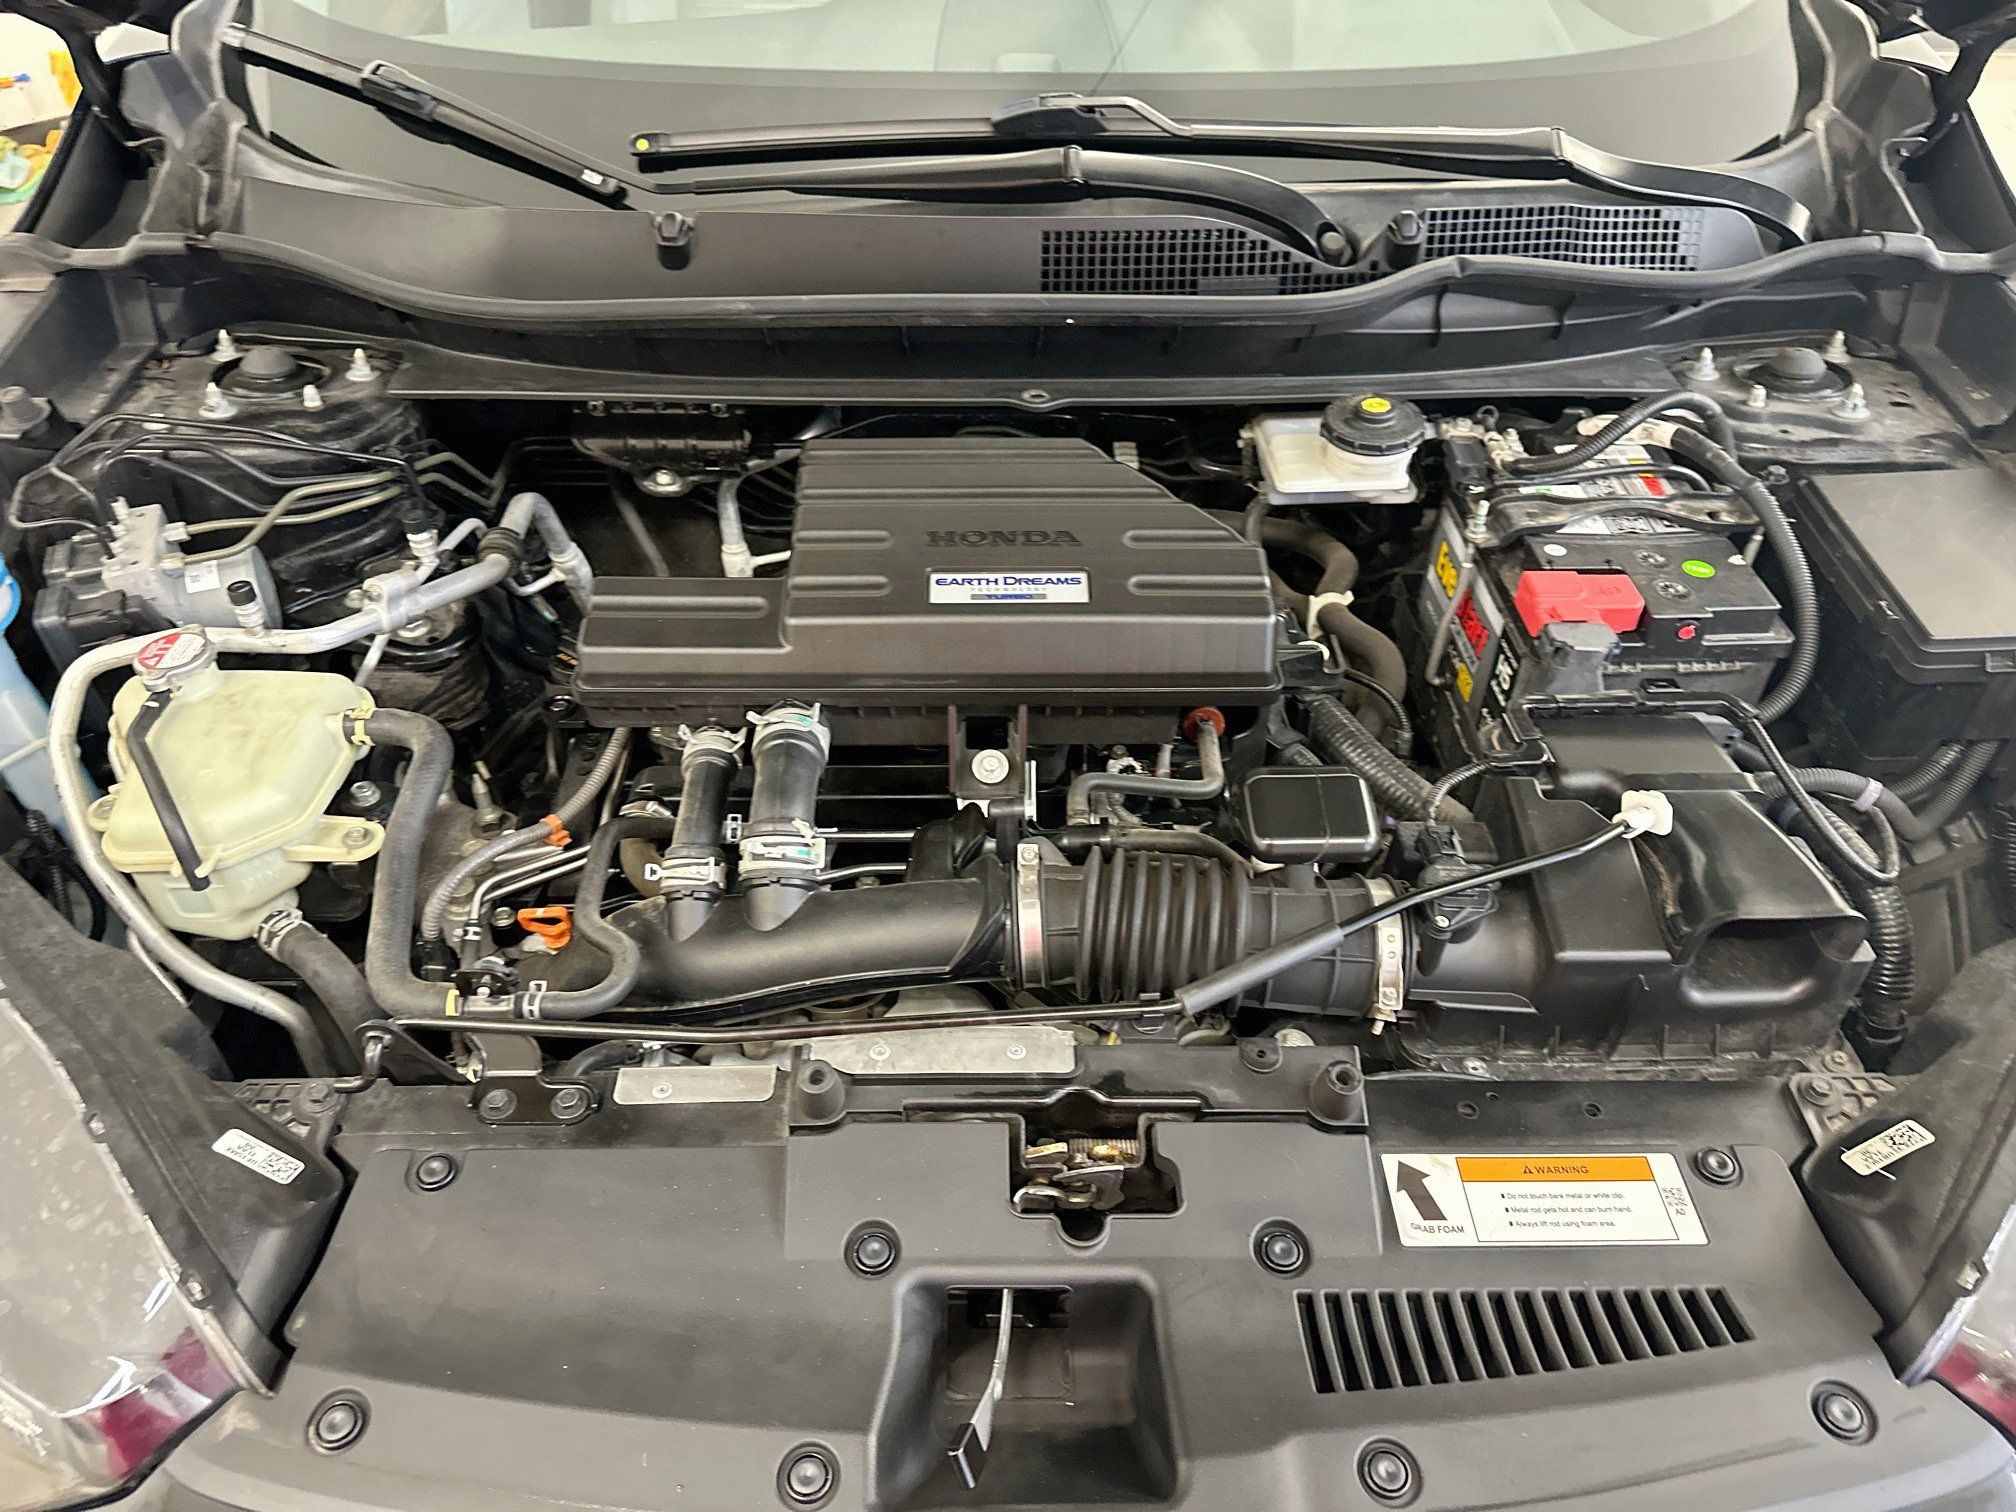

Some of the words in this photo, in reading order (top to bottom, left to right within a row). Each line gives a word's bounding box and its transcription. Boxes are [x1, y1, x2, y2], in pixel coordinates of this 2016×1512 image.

[925, 530, 1083, 547] HONDA
[935, 578, 999, 586] EARTH
[1534, 1165, 1589, 1174] WARNING
[1506, 1192, 1517, 1200] Do
[1542, 1207, 1557, 1215] gets
[1410, 1222, 1436, 1234] GRAB
[1437, 1225, 1466, 1234] FOAM
[1515, 1220, 1539, 1228] Always
